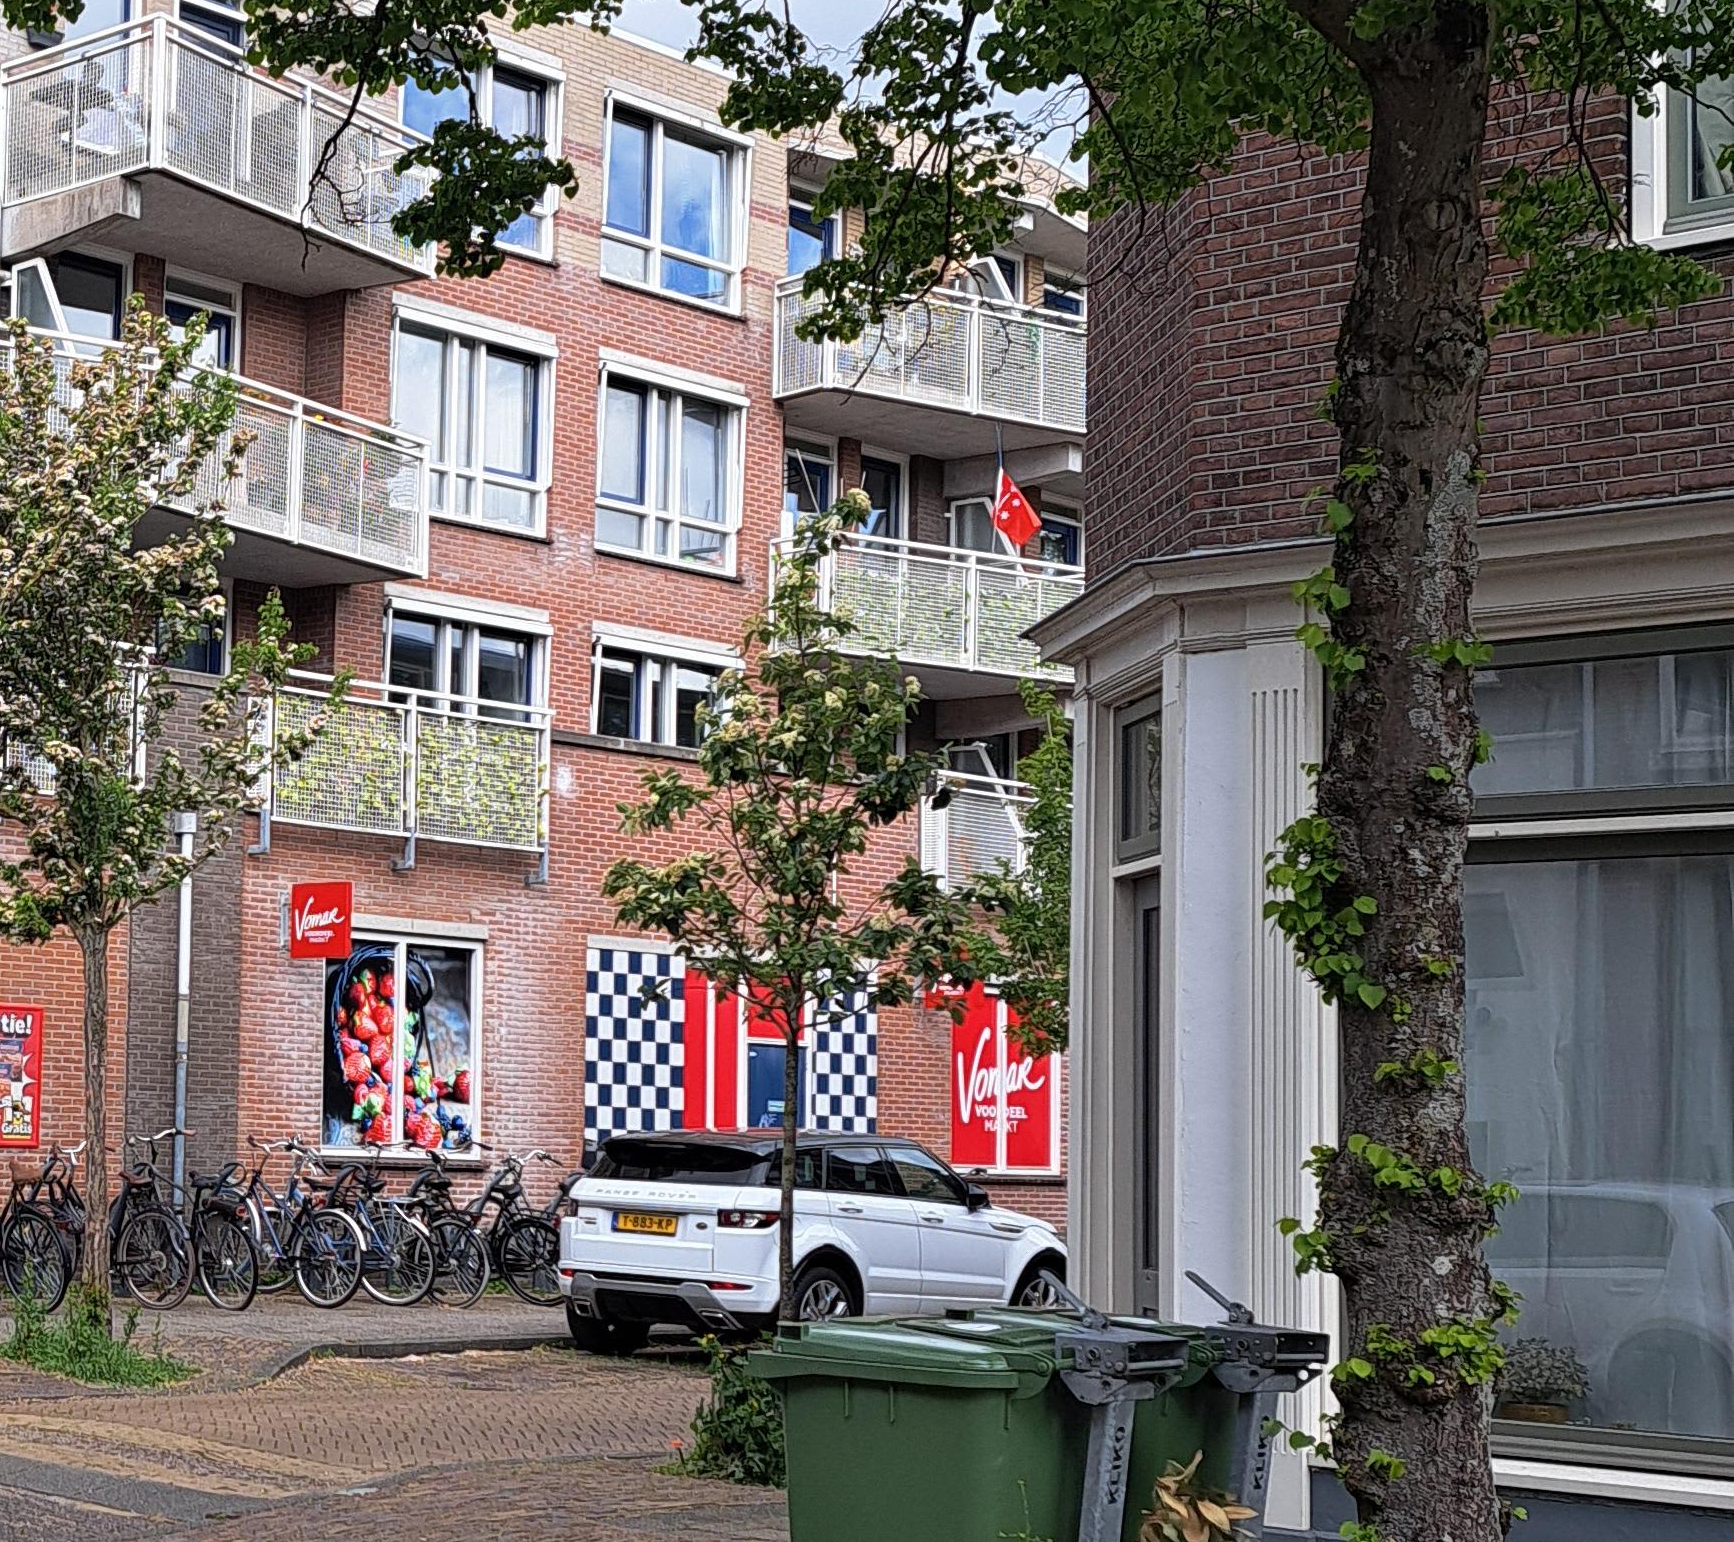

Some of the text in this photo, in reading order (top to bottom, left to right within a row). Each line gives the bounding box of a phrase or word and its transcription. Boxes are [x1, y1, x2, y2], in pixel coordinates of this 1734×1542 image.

[975, 1104, 1028, 1119] VOODEEL
[984, 1120, 1018, 1132] MAKT
[622, 1215, 674, 1231] T-883-KP
[1107, 1425, 1127, 1505] KLIKO
